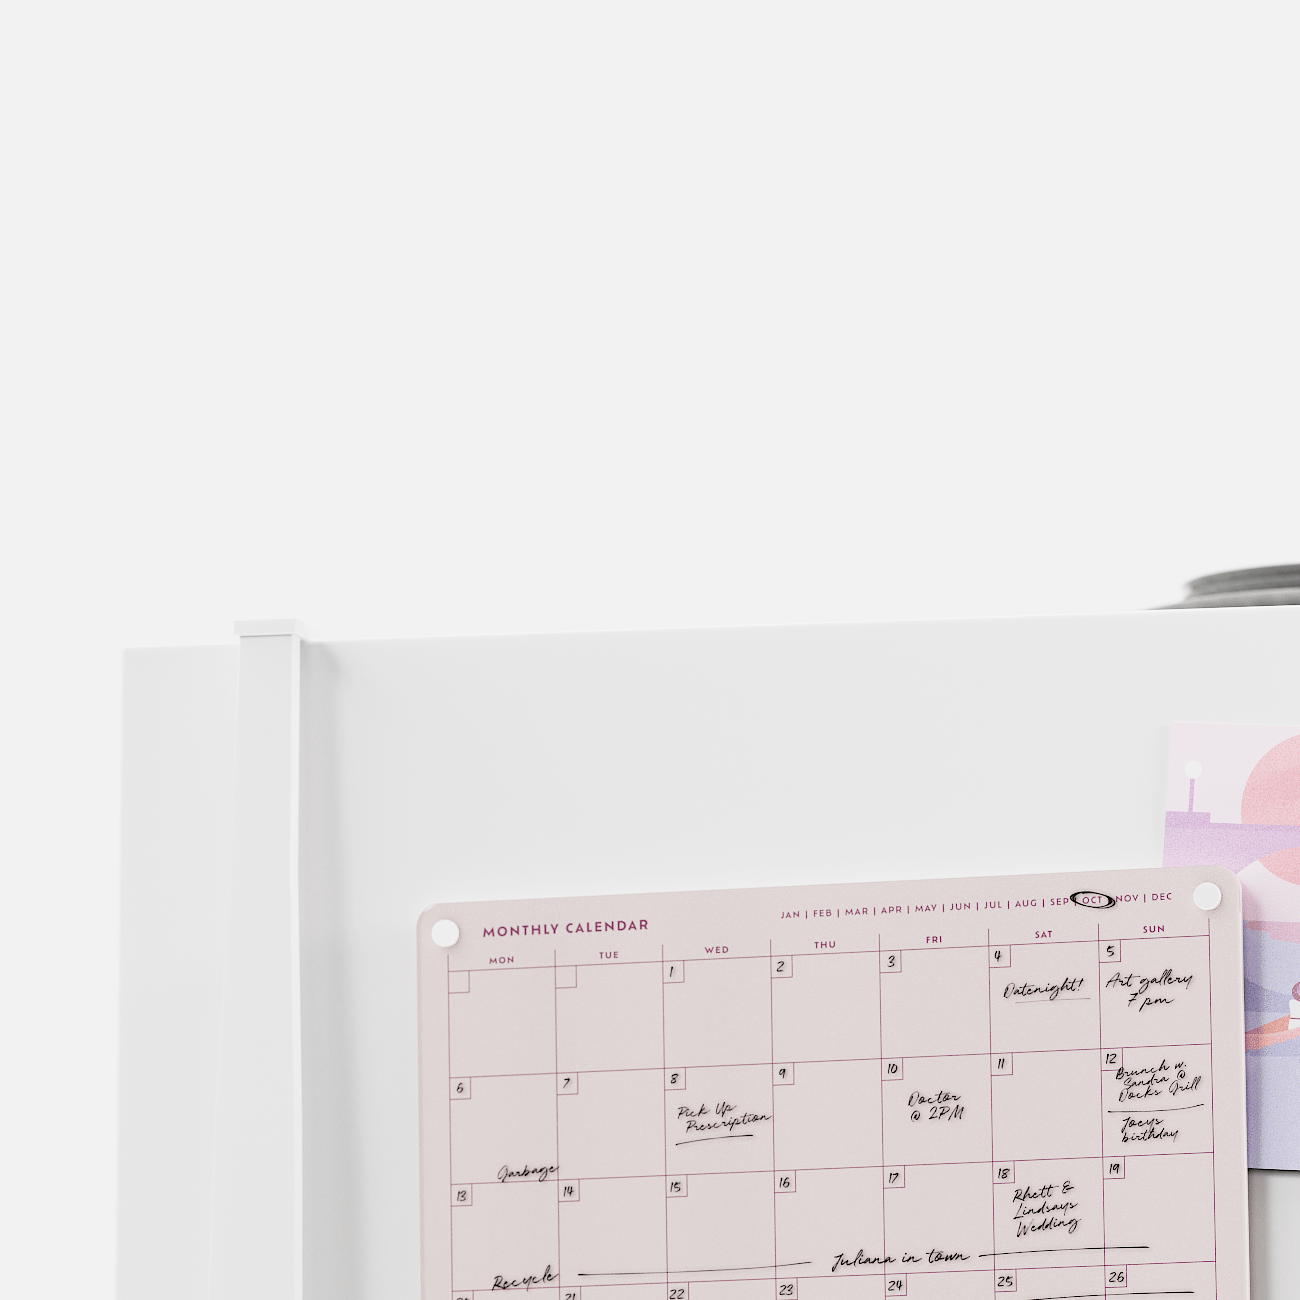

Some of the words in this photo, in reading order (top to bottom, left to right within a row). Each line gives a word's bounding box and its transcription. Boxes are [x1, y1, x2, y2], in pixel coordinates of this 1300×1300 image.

[780, 910, 800, 919] JAN
[813, 909, 832, 918] FEB
[844, 907, 869, 916] MAR
[880, 905, 902, 914] APR
[914, 903, 937, 913] MAY
[949, 902, 971, 911] JUN
[984, 900, 1002, 910] JUL
[1015, 898, 1037, 908] AUG
[1050, 897, 1069, 906] SEP
[1081, 895, 1103, 905] OCT
[1115, 894, 1139, 904] NOV
[1151, 892, 1172, 901] DEC
[482, 923, 559, 938] MONTHLY
[565, 919, 648, 934] CALENDAR
[489, 956, 514, 965] MON
[599, 951, 619, 960] TUE
[704, 945, 729, 954] WED
[814, 940, 836, 949] THU
[925, 935, 942, 944] FRI
[1034, 930, 1053, 939] SAT
[1142, 924, 1165, 934] SUN
[1106, 945, 1115, 957] 5
[888, 955, 896, 968] 3
[994, 950, 1001, 962] 4
[669, 966, 674, 978] 1
[776, 960, 785, 973] 2
[1105, 972, 1140, 988] Art
[1139, 970, 1193, 991] gallery
[1127, 991, 1140, 1007] 7
[1139, 994, 1174, 1013] pm
[997, 1058, 1005, 1069] 11
[1105, 1053, 1117, 1065] 12
[778, 1068, 786, 1079] 9
[887, 1063, 898, 1074] 10
[1115, 1060, 1169, 1081] Brunch
[563, 1077, 571, 1088] 7
[670, 1073, 679, 1084] 8
[1122, 1073, 1171, 1091] Sandra
[1175, 1068, 1186, 1082] @
[456, 1082, 464, 1093] 6
[1165, 1076, 1202, 1096] Grill
[907, 1090, 963, 1108] Doctor
[677, 1104, 708, 1119] Pick
[715, 1101, 733, 1118] Up
[910, 1110, 921, 1121] @
[928, 1104, 965, 1121] 2PM
[685, 1111, 771, 1135] Prescription
[1121, 1125, 1179, 1143] birthday
[498, 1165, 560, 1182] Garbage
[997, 1168, 1011, 1180] 18
[1109, 1163, 1120, 1175] 19
[779, 1176, 790, 1188] 16
[888, 1172, 900, 1184] 17
[563, 1186, 574, 1197] 14
[670, 1181, 681, 1192] 15
[457, 1190, 467, 1202] 13
[1012, 1184, 1059, 1205] Rhett
[1012, 1200, 1080, 1221] Lindsays
[1015, 1216, 1082, 1238] Wedding
[831, 1252, 897, 1273] Juliana
[901, 1252, 922, 1263] in
[926, 1248, 971, 1264] town
[491, 1264, 559, 1292] Recycle
[997, 1275, 1013, 1287] 25
[1108, 1271, 1125, 1283] 26
[779, 1283, 794, 1296] 23
[887, 1280, 903, 1292] 24
[670, 1288, 685, 1300] 22
